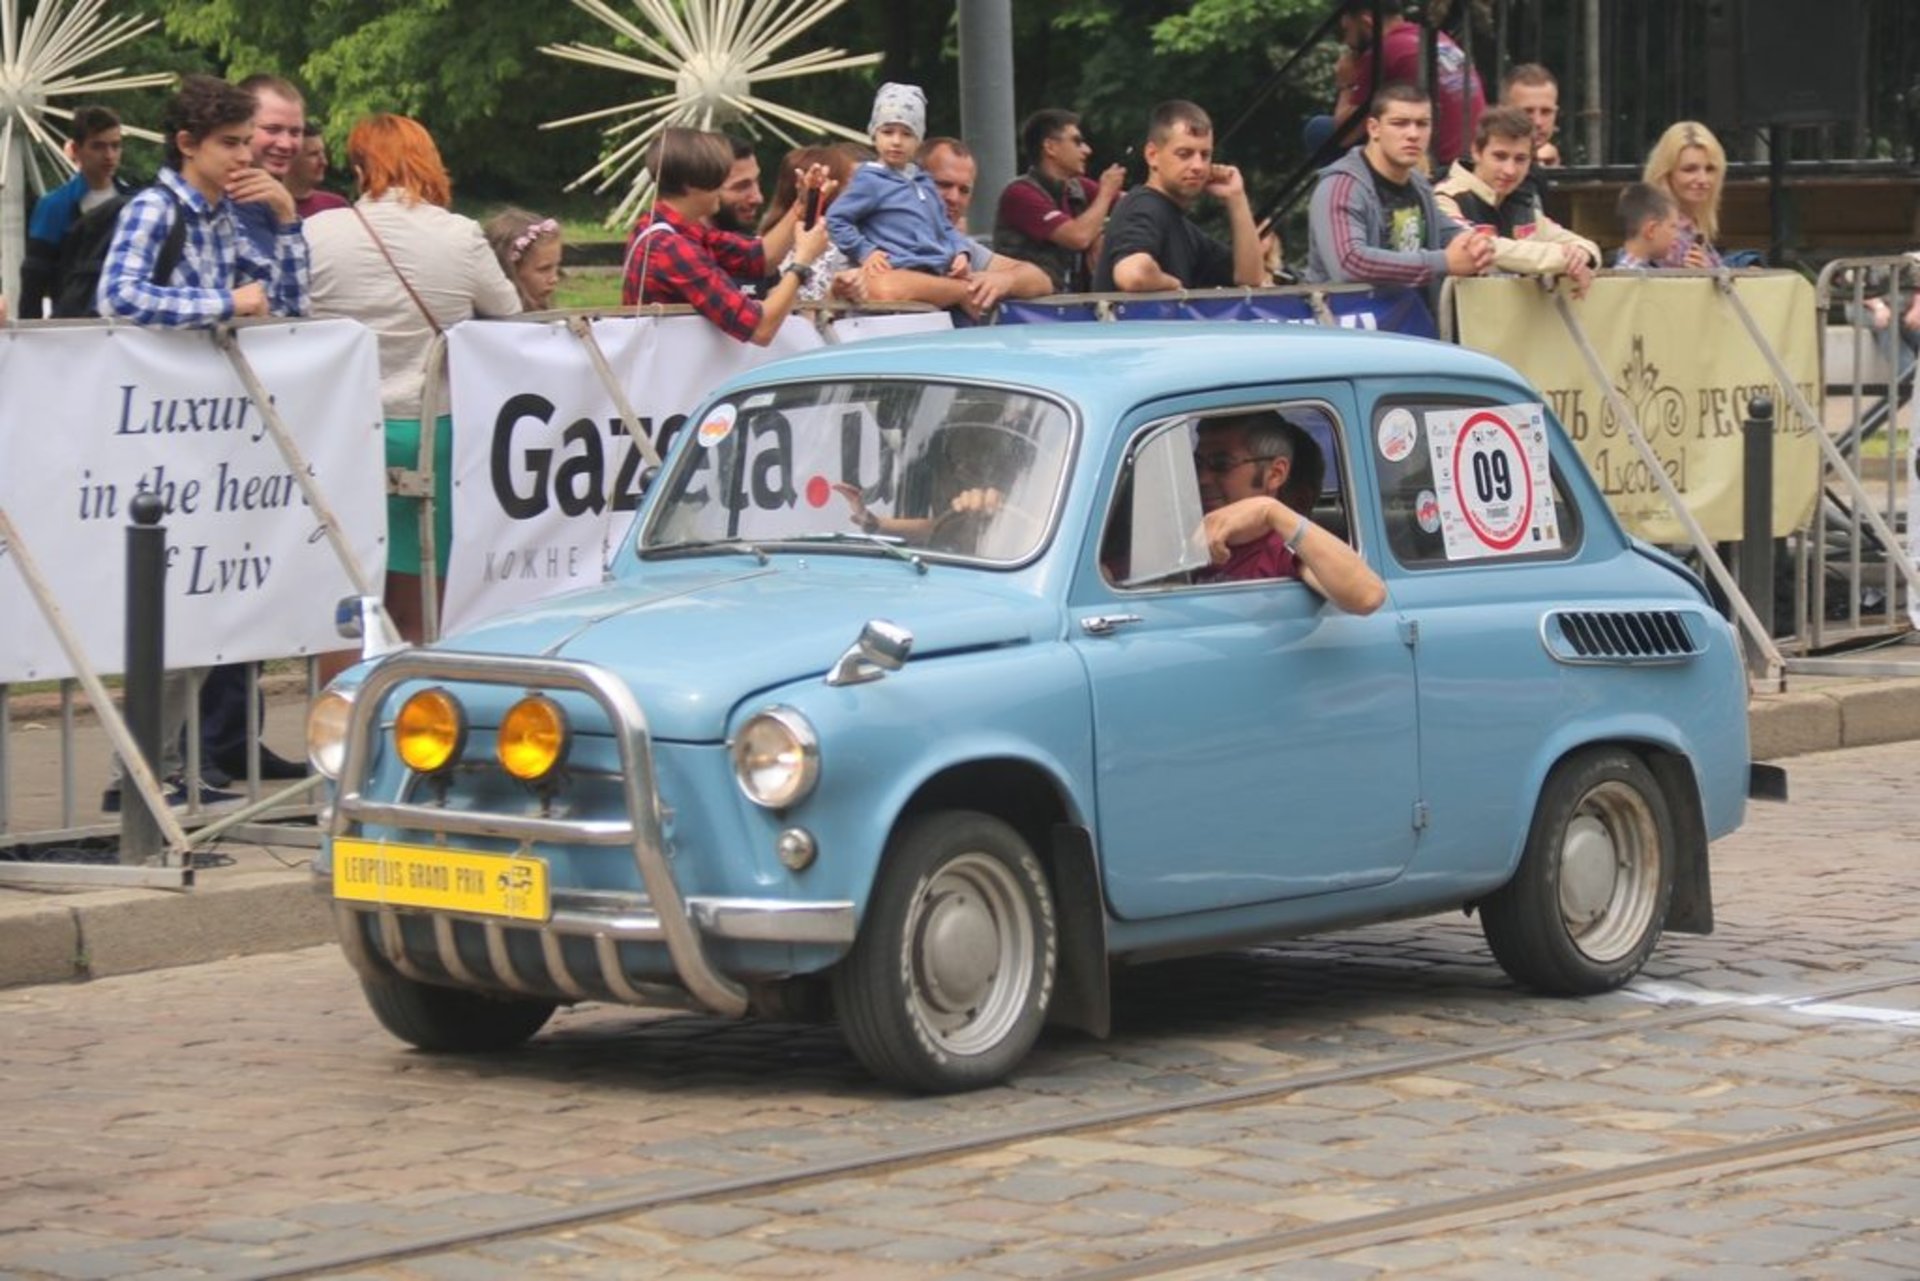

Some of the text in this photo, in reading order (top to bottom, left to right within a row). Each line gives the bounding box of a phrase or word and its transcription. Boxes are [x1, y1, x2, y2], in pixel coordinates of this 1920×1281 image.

[79, 469, 117, 521] in
[1473, 448, 1513, 503] 09
[184, 541, 272, 597] Lviv
[344, 856, 486, 895] LEOPOLIS GRAND PRIX
